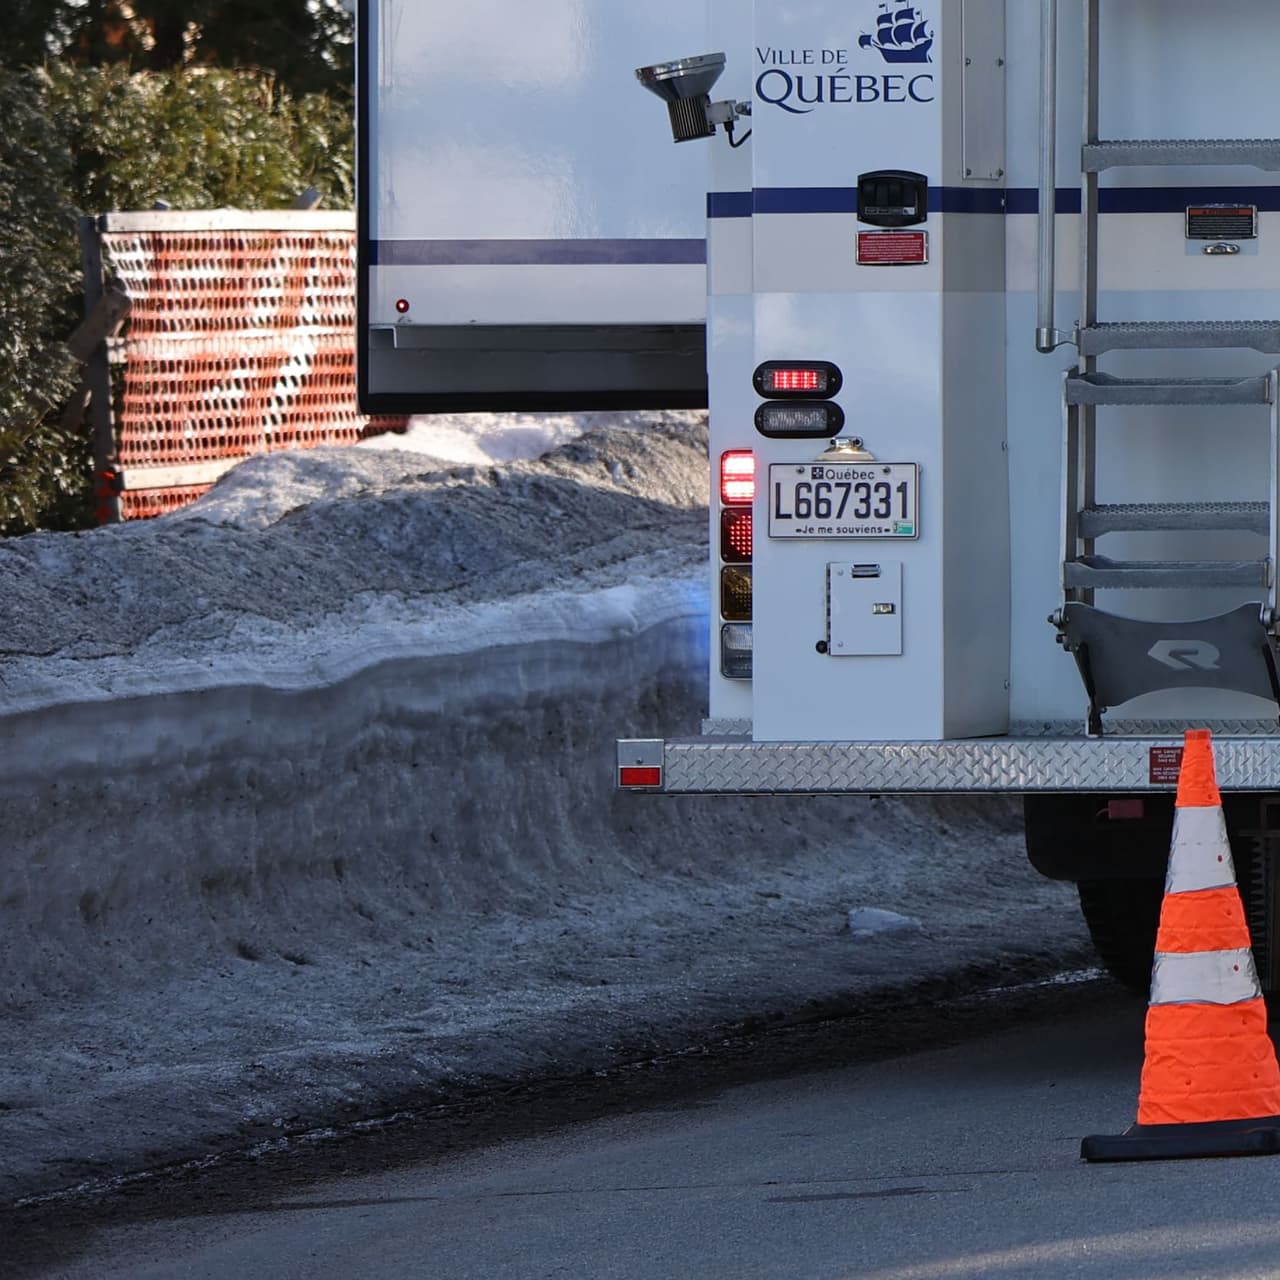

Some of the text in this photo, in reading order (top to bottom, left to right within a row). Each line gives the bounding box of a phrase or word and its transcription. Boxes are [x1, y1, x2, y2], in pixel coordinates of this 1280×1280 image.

[756, 46, 848, 66] VILLE DE
[755, 66, 935, 114] QUÉBEC
[825, 468, 876, 481] Québec
[774, 481, 908, 520] L667331
[801, 524, 883, 534] Je me souviens
